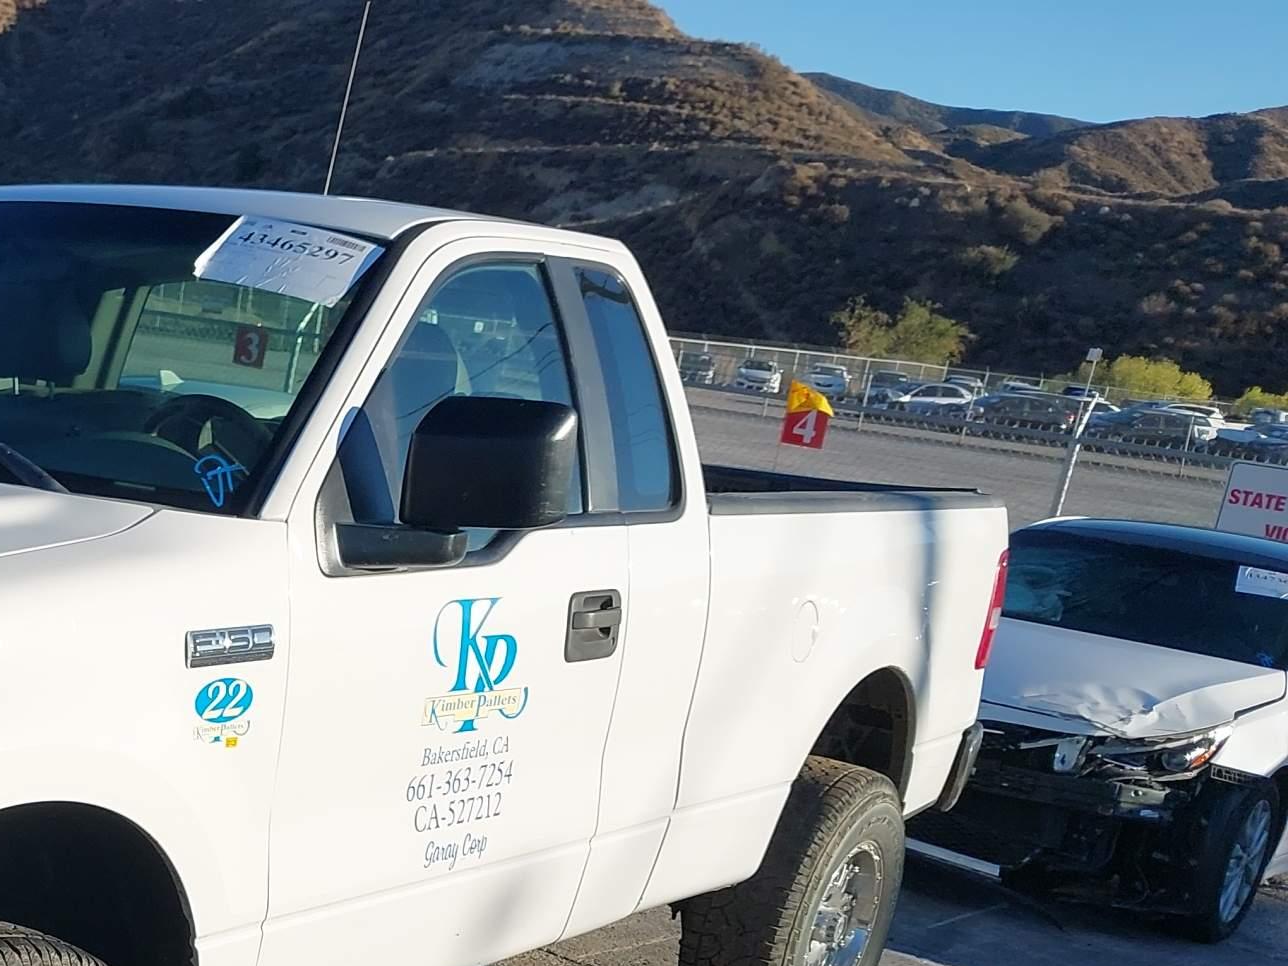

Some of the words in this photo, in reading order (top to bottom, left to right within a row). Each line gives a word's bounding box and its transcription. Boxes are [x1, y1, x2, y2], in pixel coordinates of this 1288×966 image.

[238, 230, 355, 266] 43465297
[239, 332, 260, 364] 3
[792, 408, 818, 444] 4
[1228, 488, 1288, 512] STATE
[201, 680, 248, 720] 22
[420, 698, 476, 731] Kimber
[475, 687, 528, 719] Pallets
[421, 738, 489, 767] Bakersfield,
[492, 735, 509, 755] CA
[406, 759, 514, 802] 661-363-7254
[414, 791, 502, 833] CA-527212
[423, 840, 459, 871] Garay
[462, 832, 488, 859] Corp
